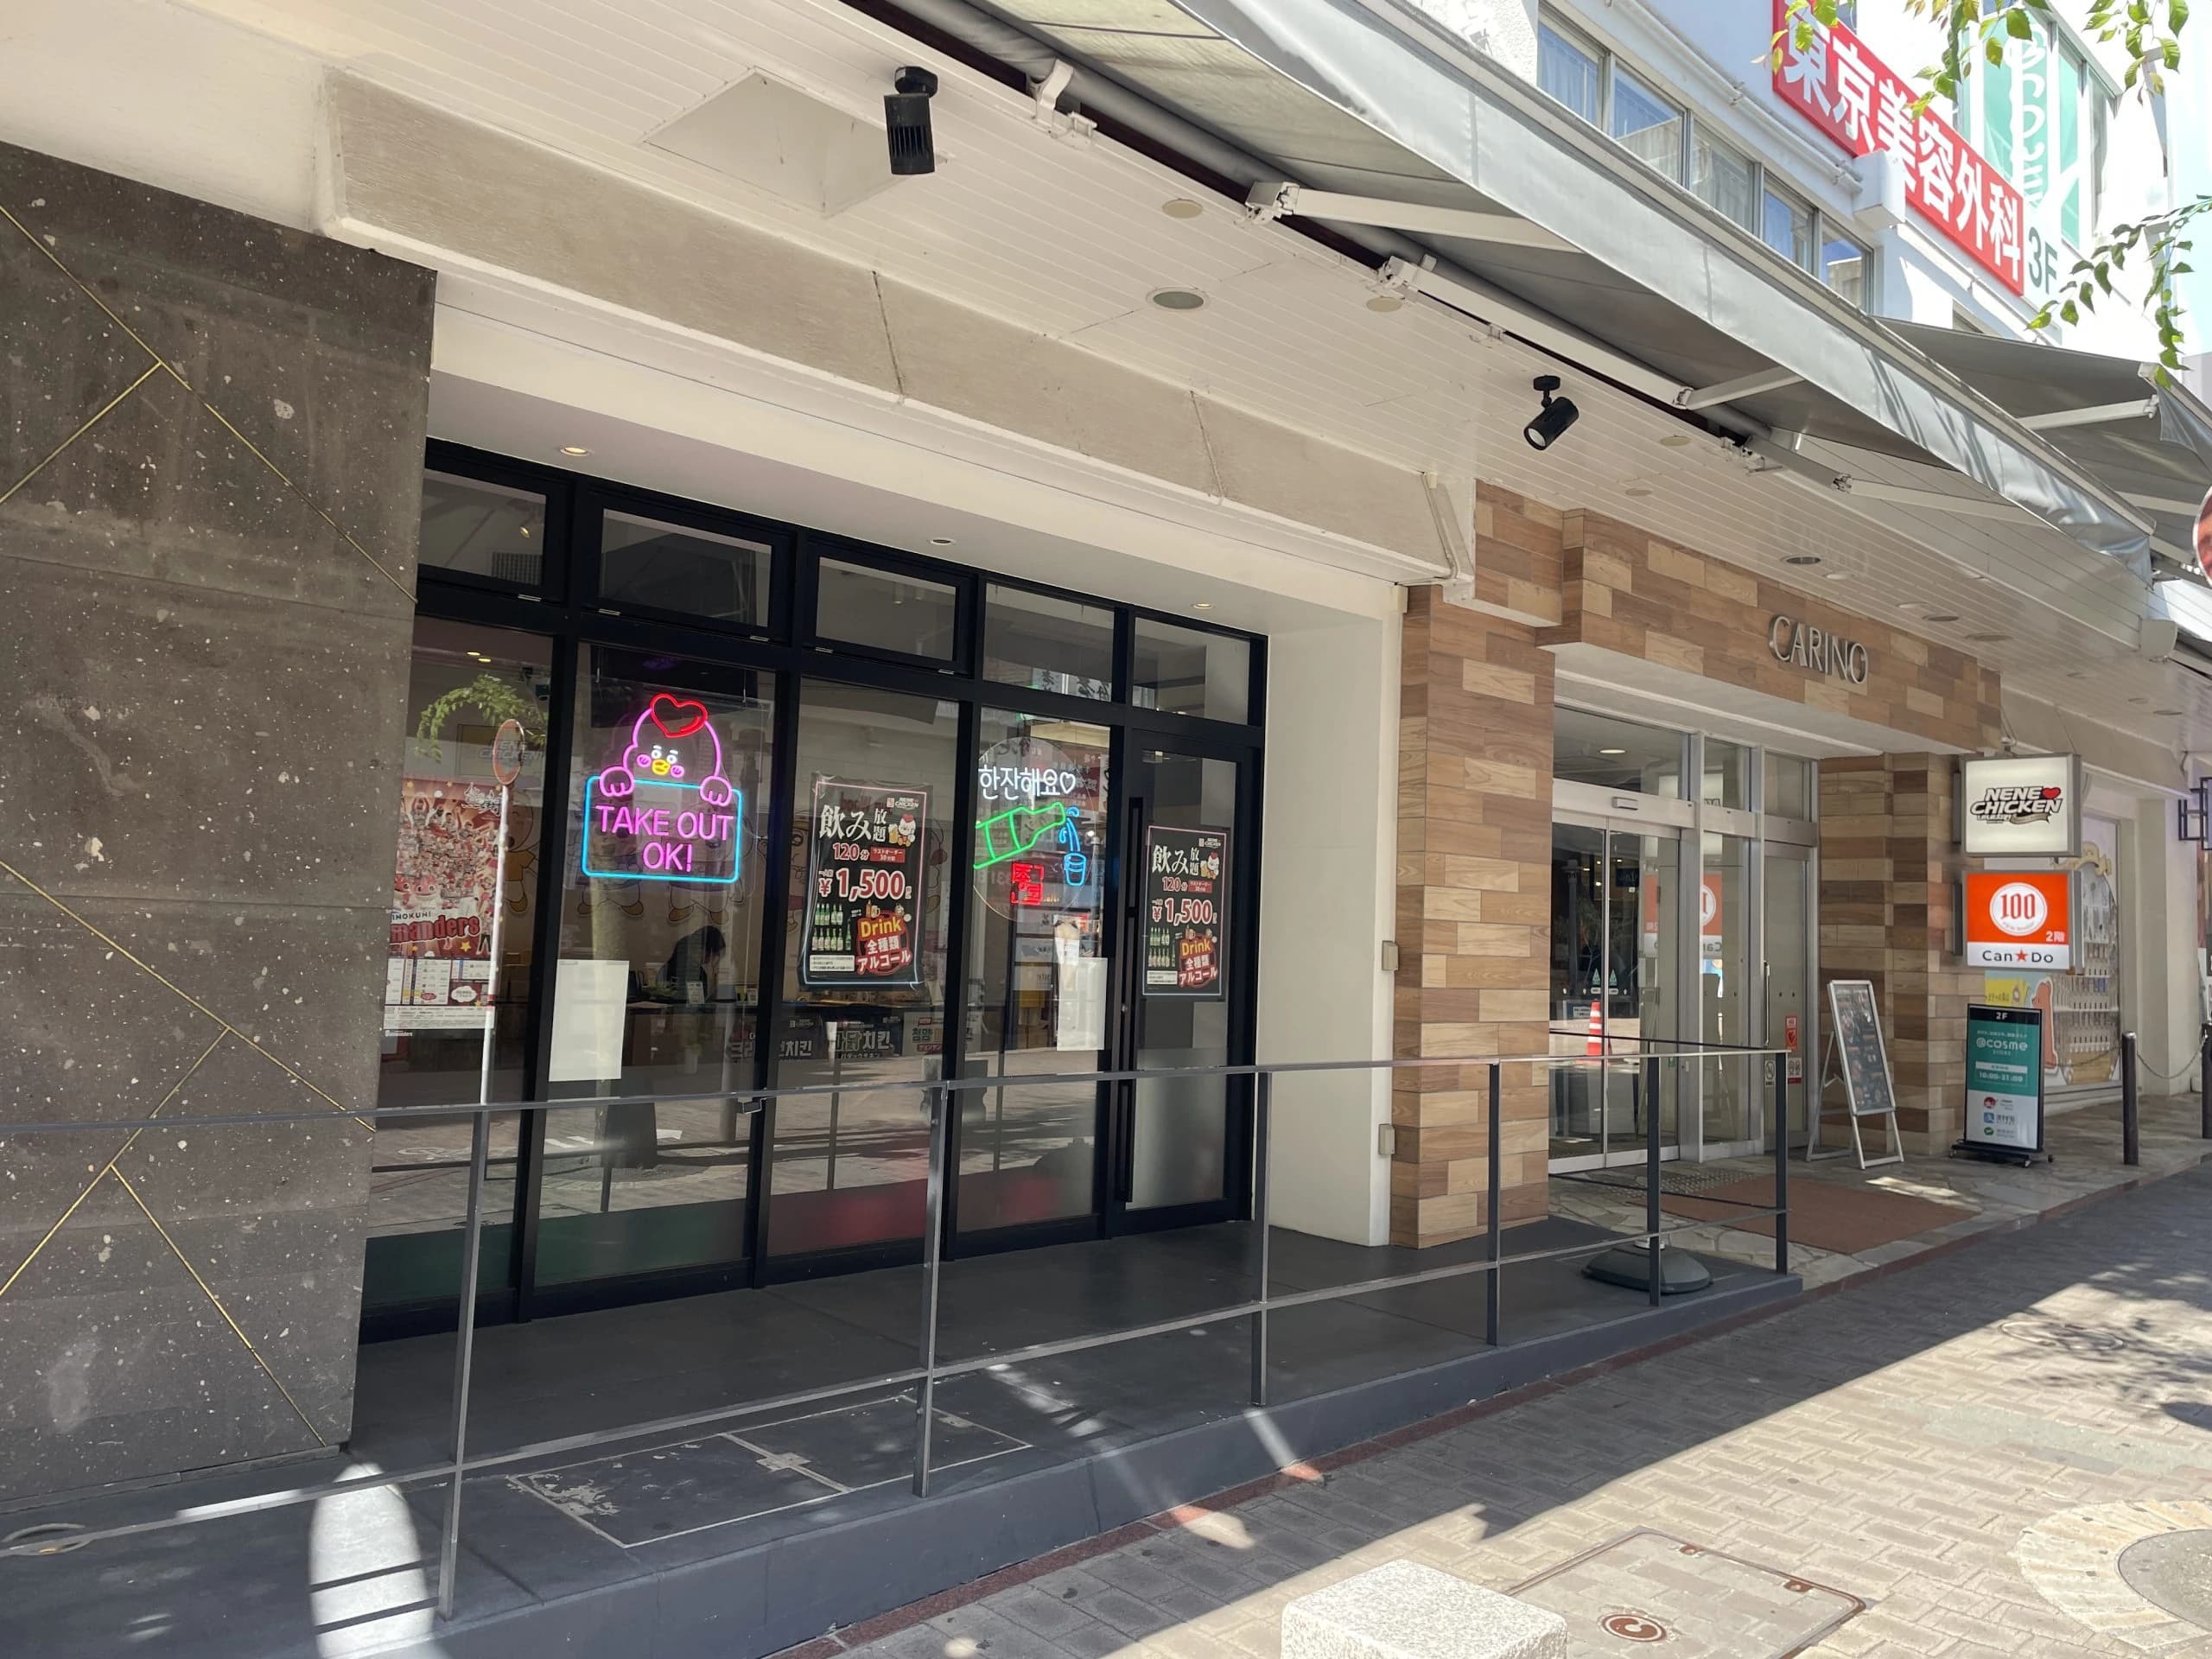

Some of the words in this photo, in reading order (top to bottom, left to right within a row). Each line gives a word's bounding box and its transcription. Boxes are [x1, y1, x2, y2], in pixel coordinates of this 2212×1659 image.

[1783, 0, 2022, 283] 東京美容外科
[2029, 226, 2058, 295] 3F
[1769, 614, 1868, 685] CARINO
[978, 764, 1061, 801] 한잔해요
[1984, 786, 2043, 802] NENE
[1970, 799, 2063, 815] CHICKEN
[595, 804, 670, 836] TAKE
[677, 810, 734, 841] OUT
[819, 804, 888, 842] 飲み放題
[642, 842, 693, 873] OK!
[832, 842, 870, 861] 120分
[2000, 893, 2036, 920] 100
[391, 915, 480, 943] manders
[861, 917, 902, 938] Drink
[857, 950, 911, 972] アルコール
[1181, 938, 1211, 957] Drink
[1179, 967, 1217, 985] アルコール
[1976, 1037, 2028, 1052] @cosme
